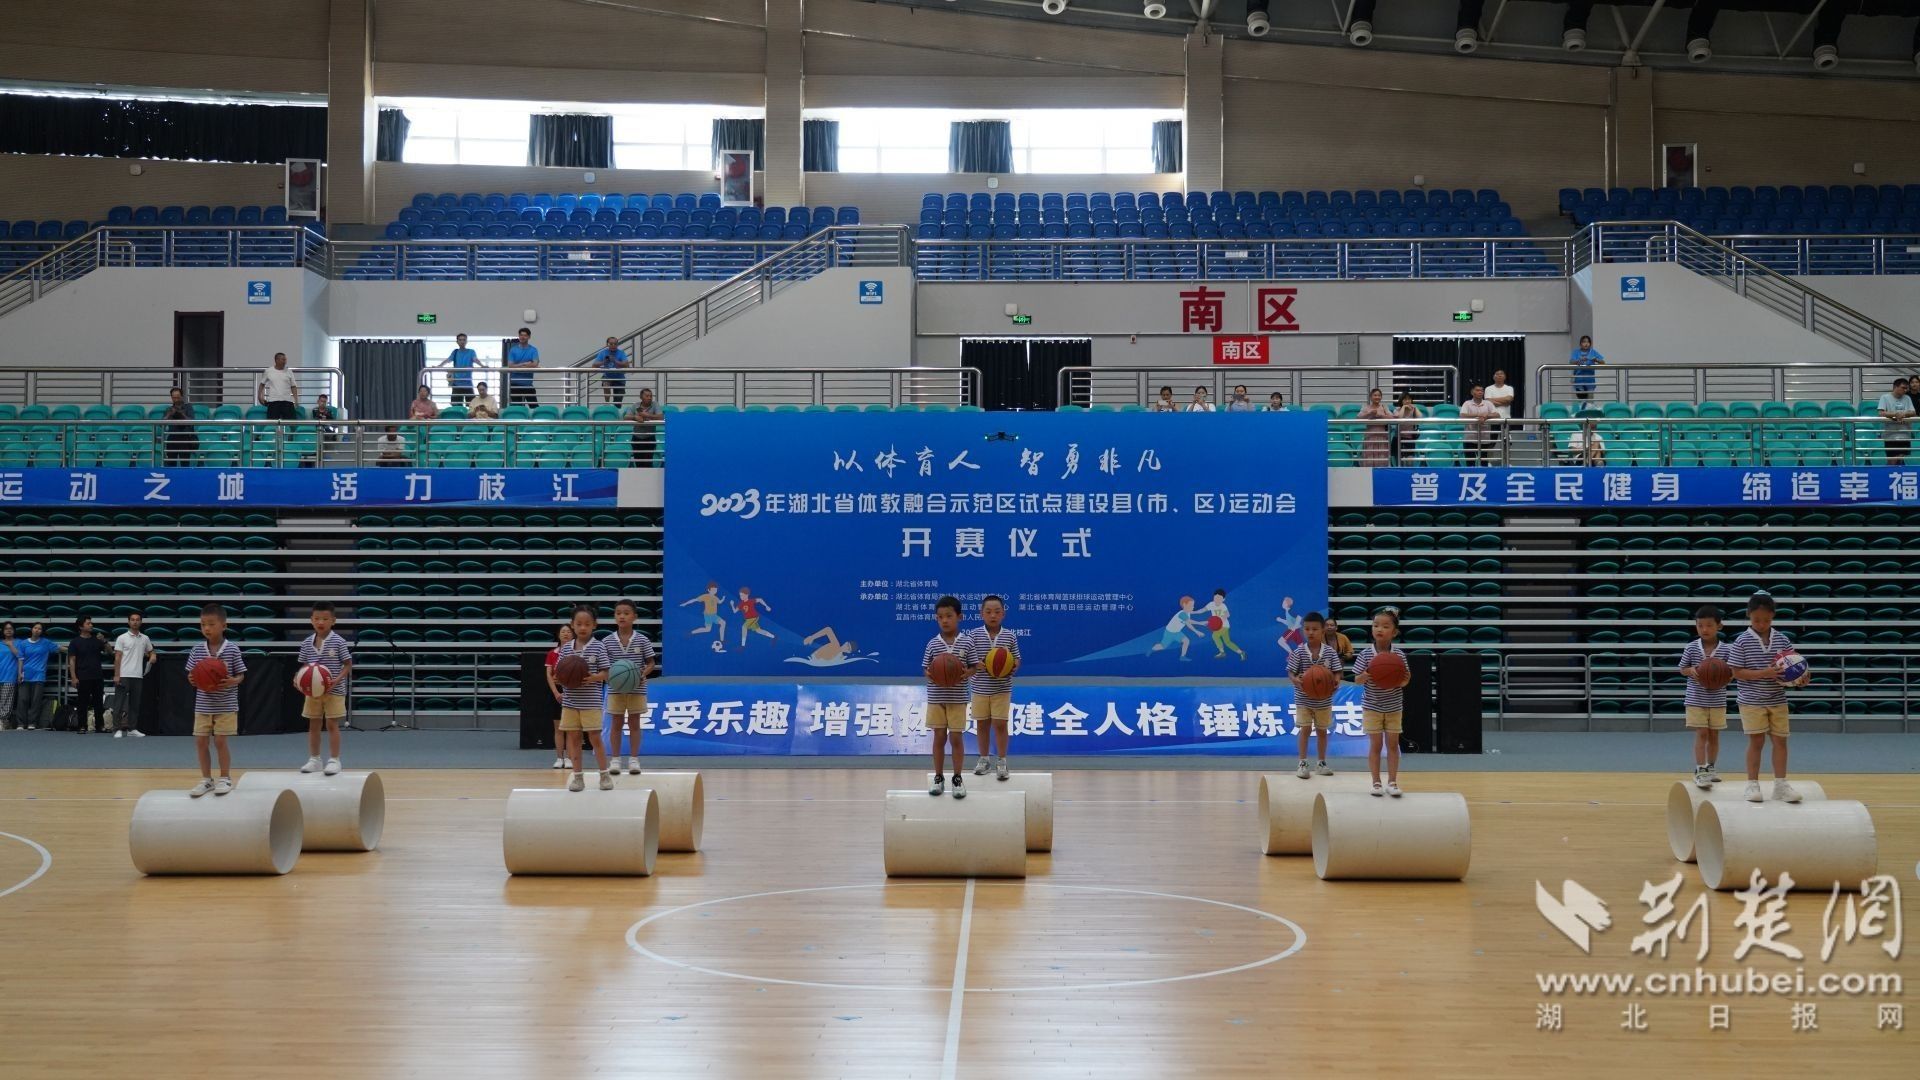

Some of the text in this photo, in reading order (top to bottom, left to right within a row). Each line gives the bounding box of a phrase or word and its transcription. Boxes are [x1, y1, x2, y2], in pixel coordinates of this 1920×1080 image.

[1180, 286, 1300, 332] 南区
[1221, 341, 1262, 360] 南区
[834, 445, 980, 478] 以体育人
[0, 472, 579, 501] 运动之城 活力枝江
[1411, 471, 1918, 501] 普及全民健身 缔造幸福
[902, 527, 1092, 558] 开赛仪式
[1007, 702, 1178, 736] 健全人格
[1197, 702, 1366, 737] 锤炼志
